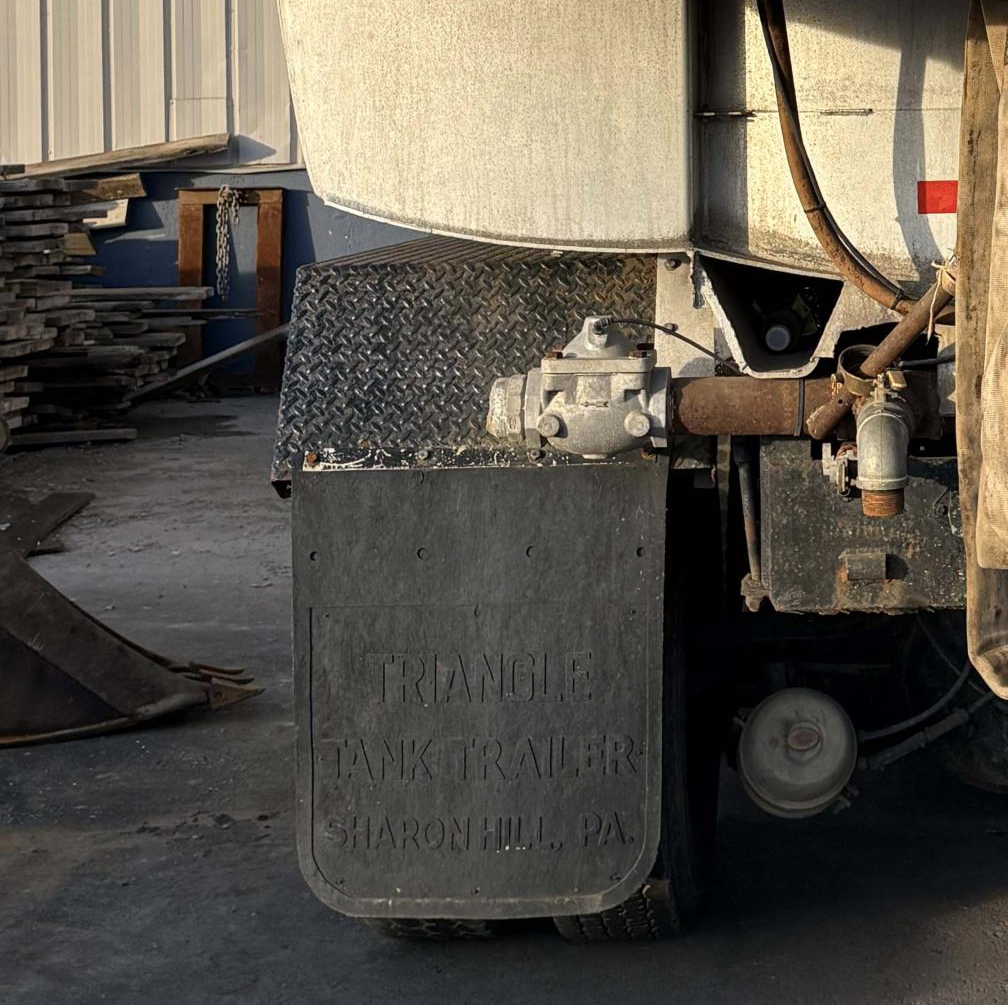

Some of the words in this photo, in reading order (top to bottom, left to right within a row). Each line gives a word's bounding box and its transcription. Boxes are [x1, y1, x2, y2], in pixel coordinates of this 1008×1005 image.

[366, 651, 593, 703] TRIANGLE
[320, 738, 433, 781] TANK
[447, 735, 638, 780] TRAILER
[325, 815, 471, 852] SHARON
